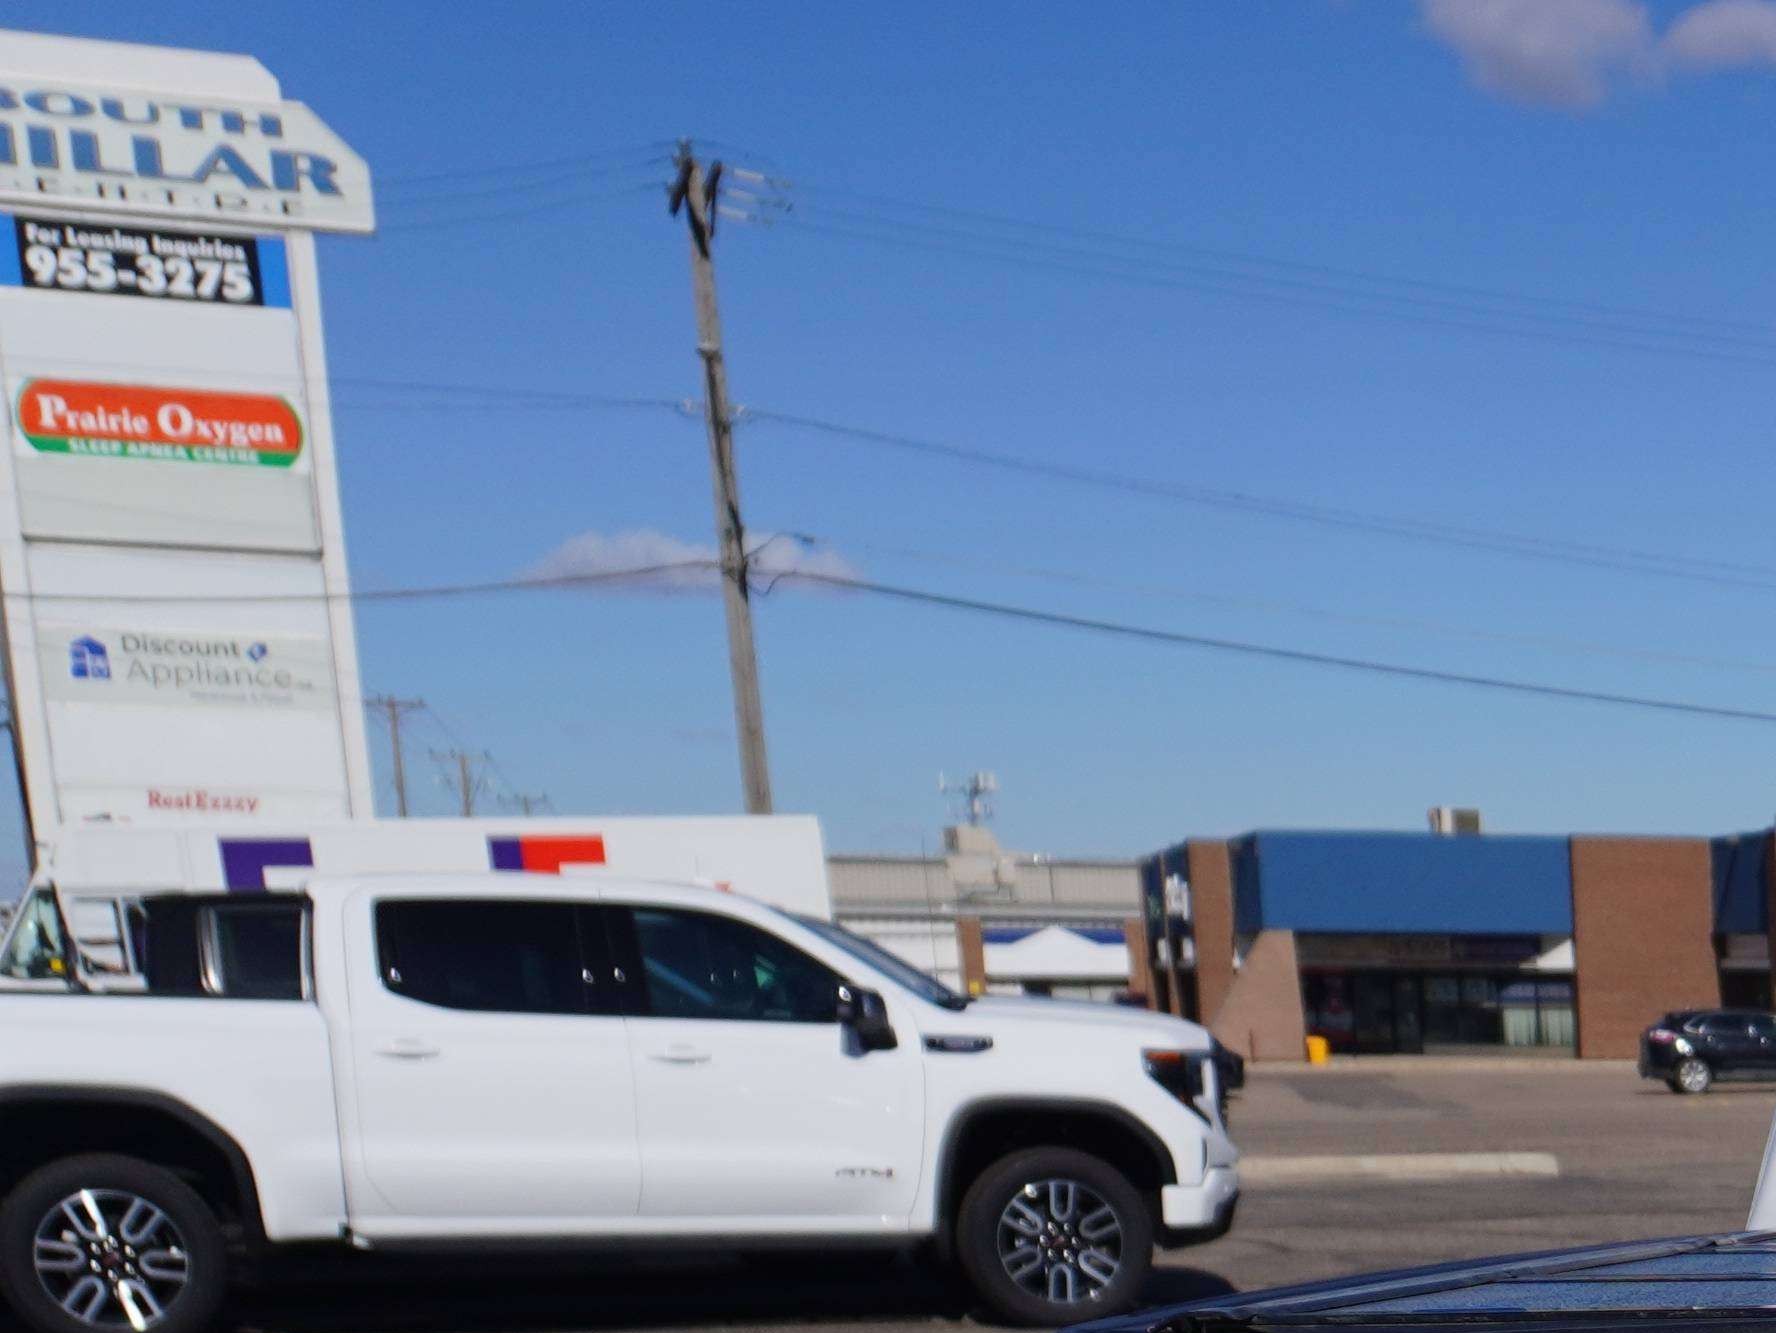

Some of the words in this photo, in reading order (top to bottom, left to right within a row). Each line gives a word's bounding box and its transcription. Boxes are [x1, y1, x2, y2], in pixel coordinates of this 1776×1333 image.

[26, 245, 254, 302] 955-3275
[37, 392, 149, 434] Prairie
[157, 402, 285, 447] Oxygen
[121, 634, 240, 658] Discount
[127, 658, 292, 689] Appliance
